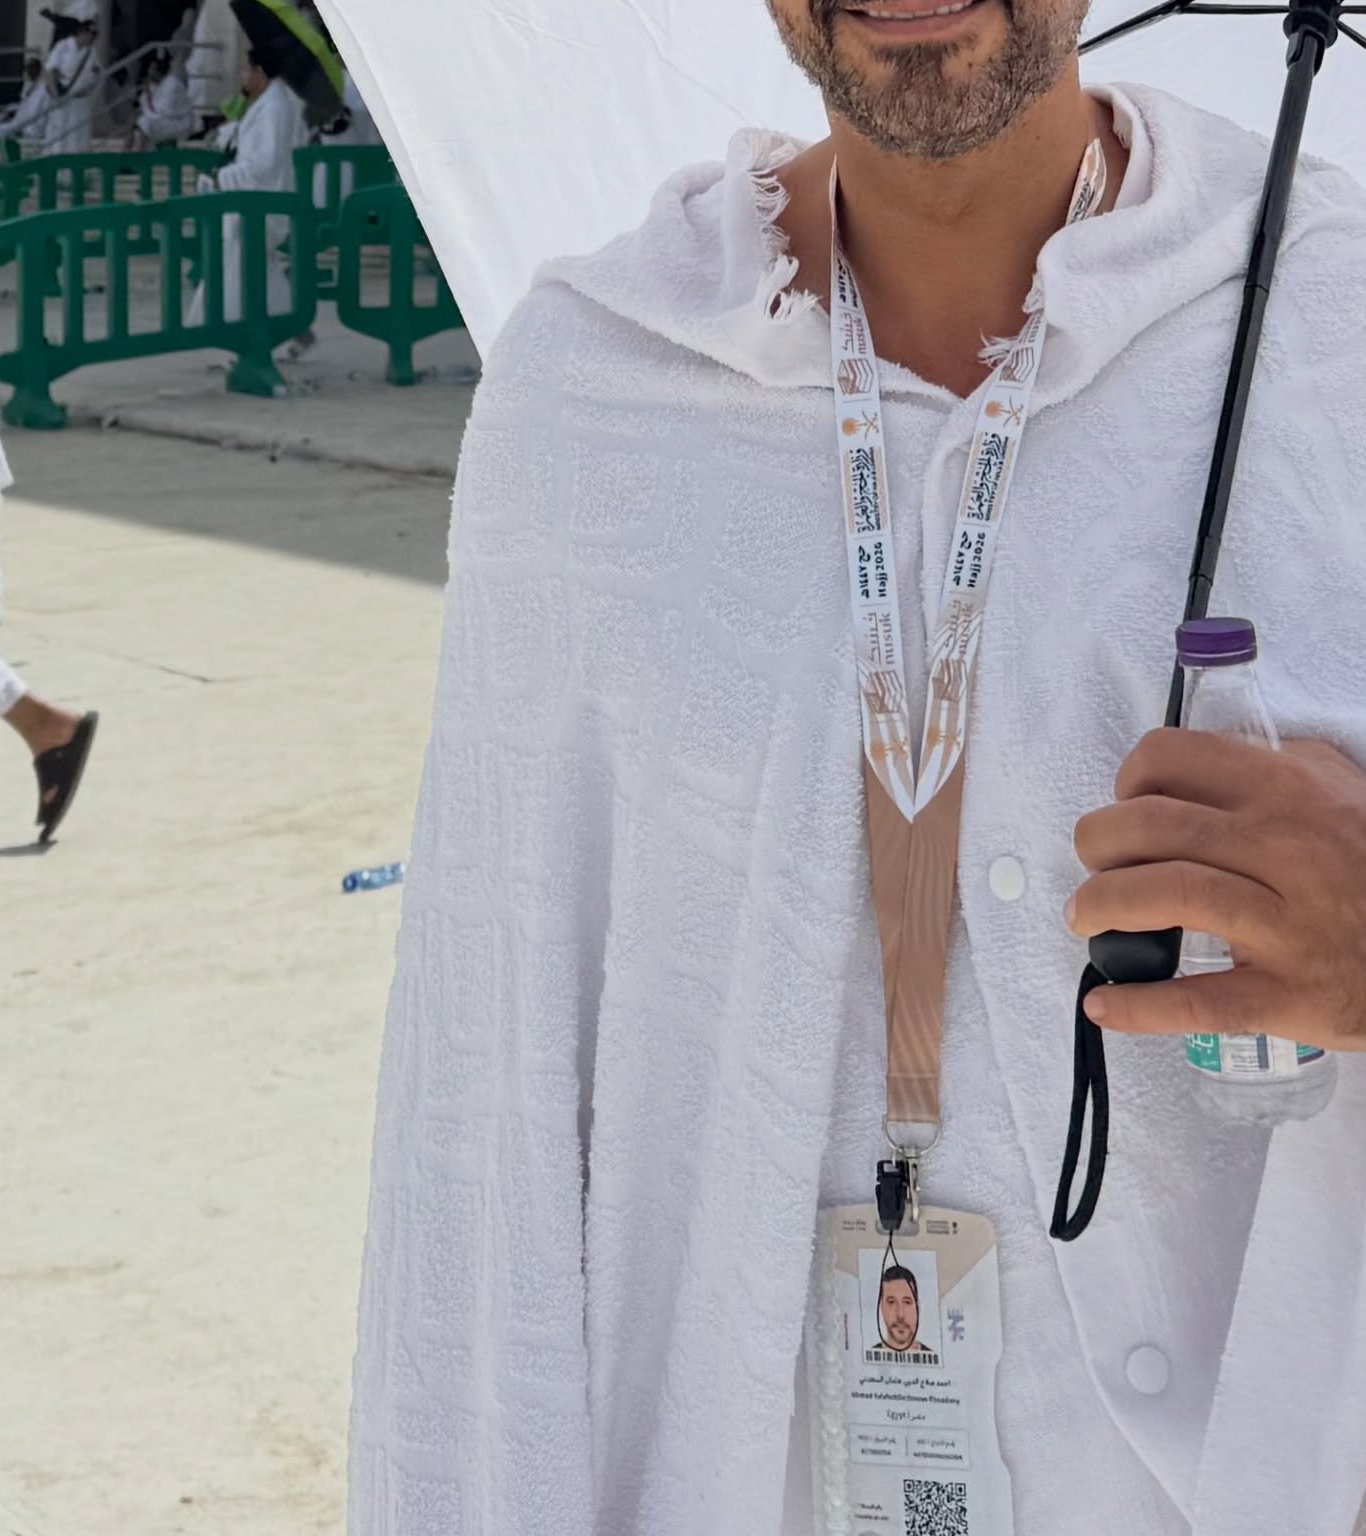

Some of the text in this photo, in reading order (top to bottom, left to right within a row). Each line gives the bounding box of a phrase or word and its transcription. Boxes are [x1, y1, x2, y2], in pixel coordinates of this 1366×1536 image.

[858, 544, 871, 564] حج
[959, 530, 973, 550] حج
[966, 532, 986, 589] Hajj 2026
[874, 541, 889, 598] Hajj 2026
[878, 611, 895, 665] nusuk
